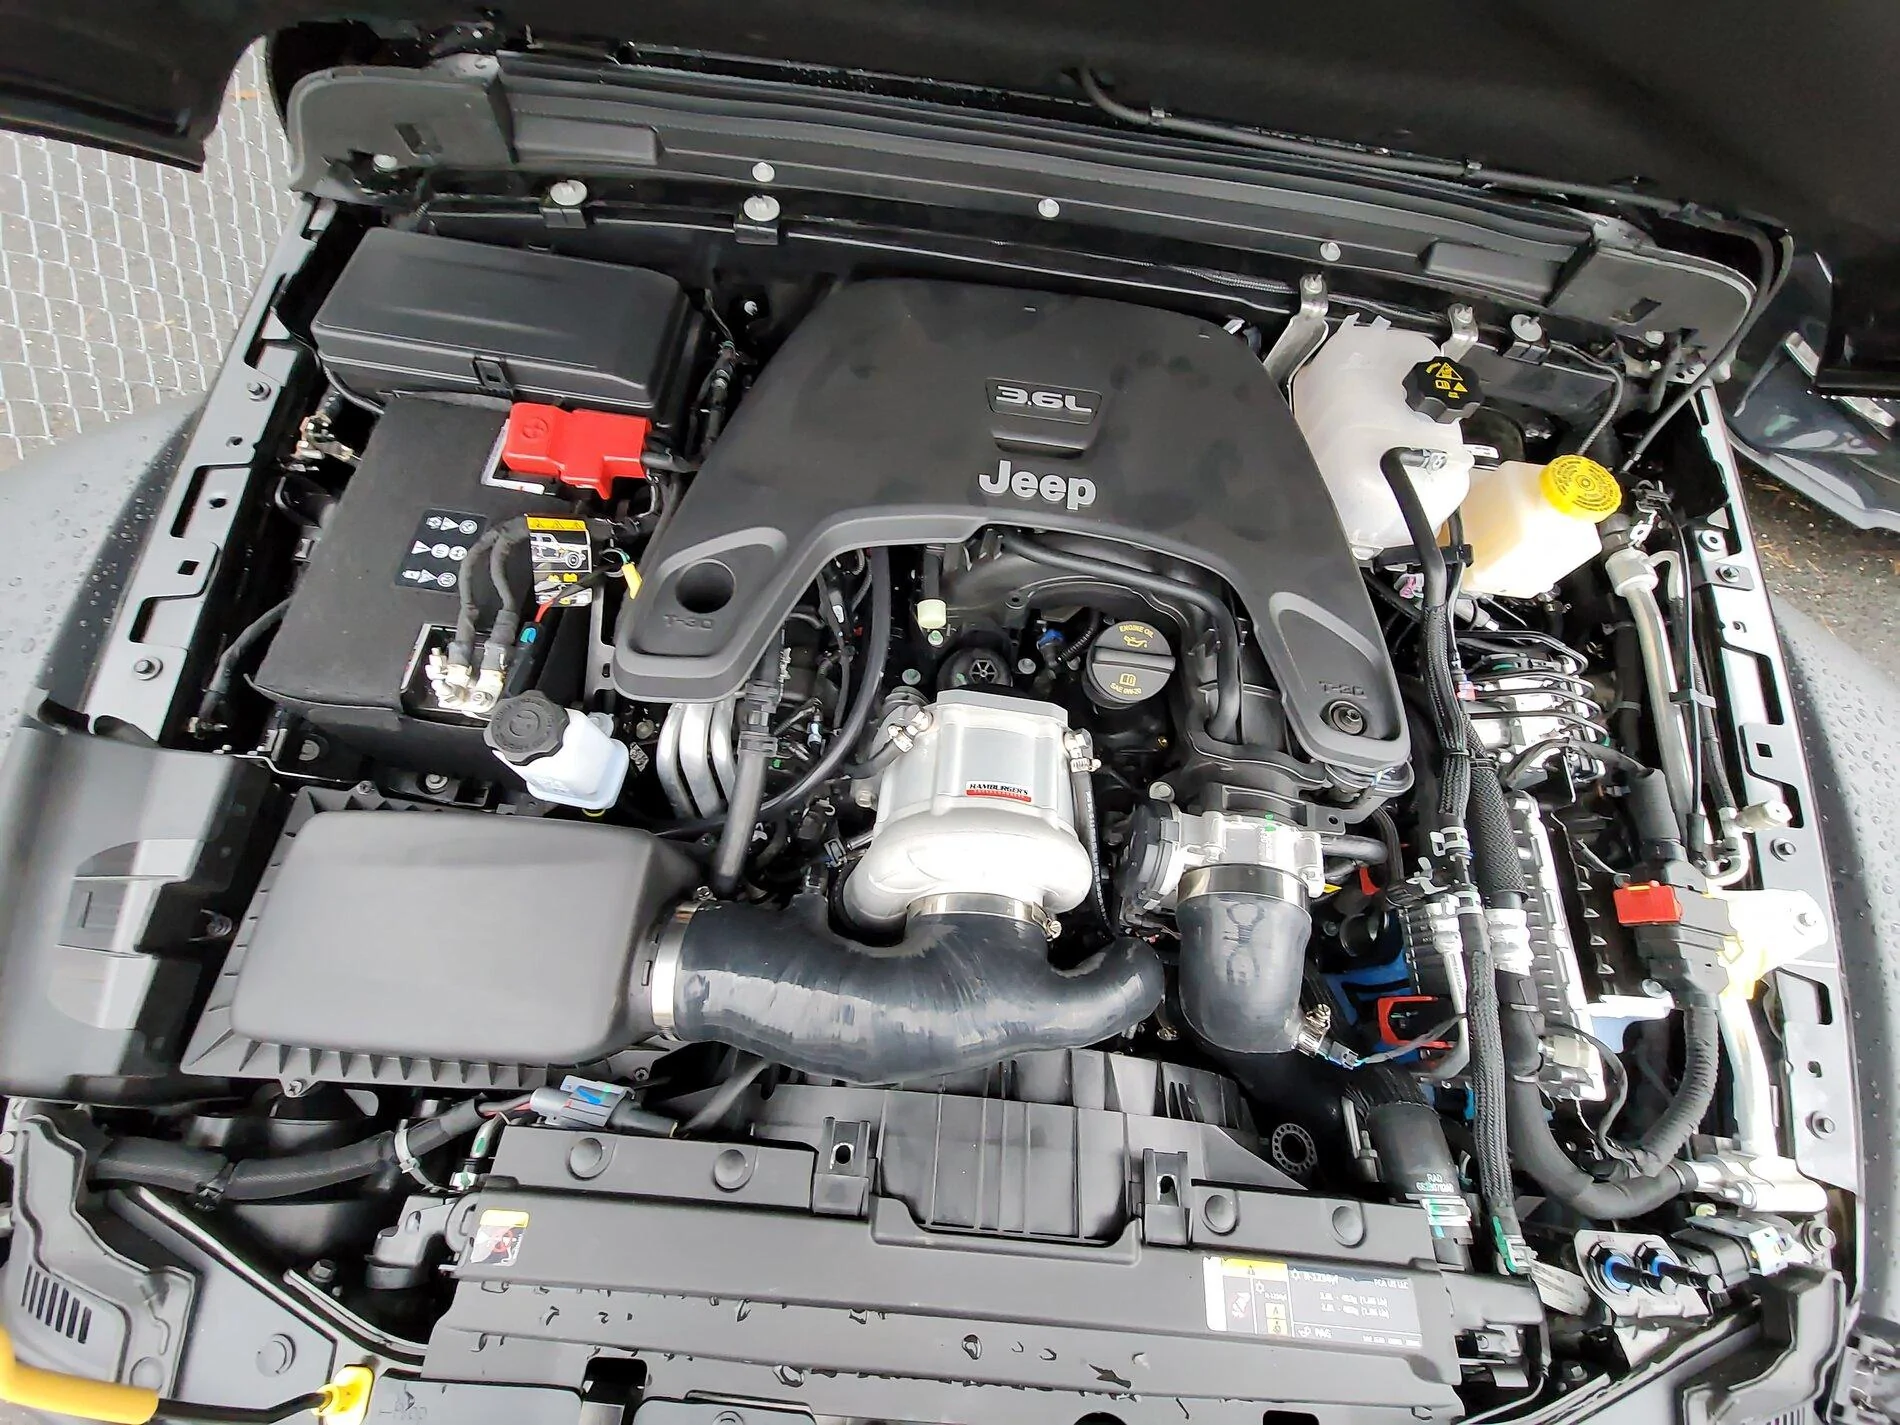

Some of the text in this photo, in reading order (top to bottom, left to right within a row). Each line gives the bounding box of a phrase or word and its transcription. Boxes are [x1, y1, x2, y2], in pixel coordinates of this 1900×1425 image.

[995, 385, 1093, 413] 3.6L
[978, 459, 1097, 510] Jeep
[1119, 625, 1154, 638] ENGINE OIL
[1110, 683, 1123, 694] SAE
[1426, 1173, 1443, 1184] RAD
